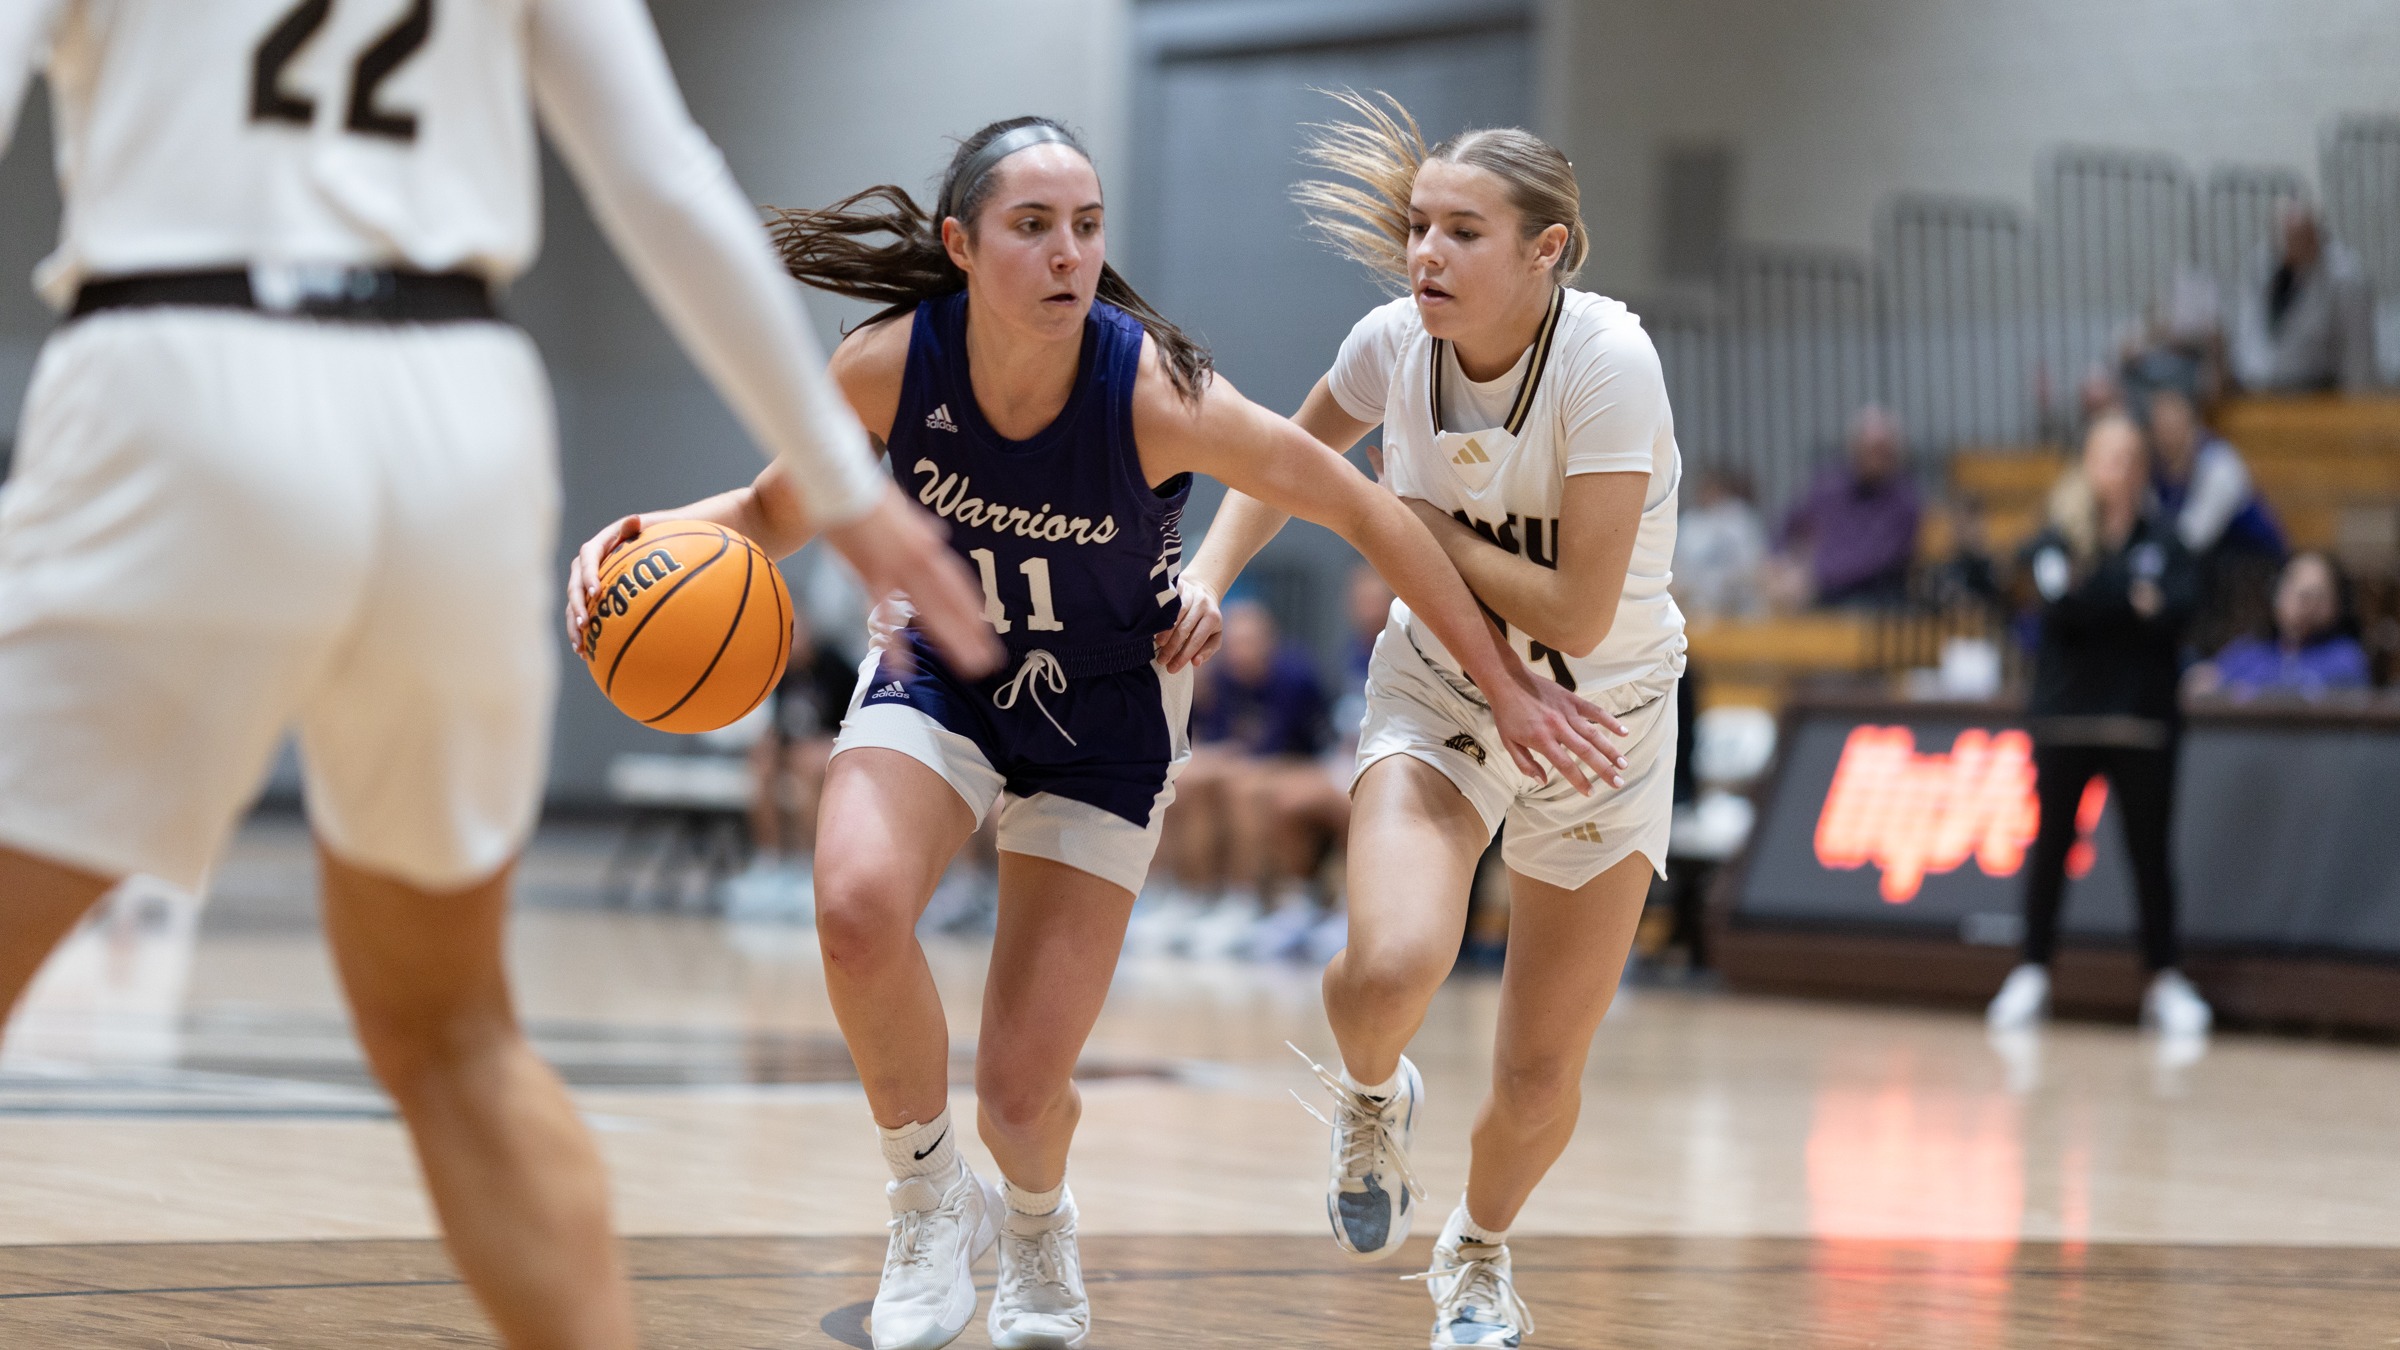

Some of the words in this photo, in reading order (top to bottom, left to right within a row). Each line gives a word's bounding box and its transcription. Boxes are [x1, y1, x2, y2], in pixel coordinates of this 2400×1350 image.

[250, 0, 433, 142] 22
[913, 457, 1119, 545] Warriors
[969, 548, 1064, 634] 11
[871, 690, 910, 699] adidas
